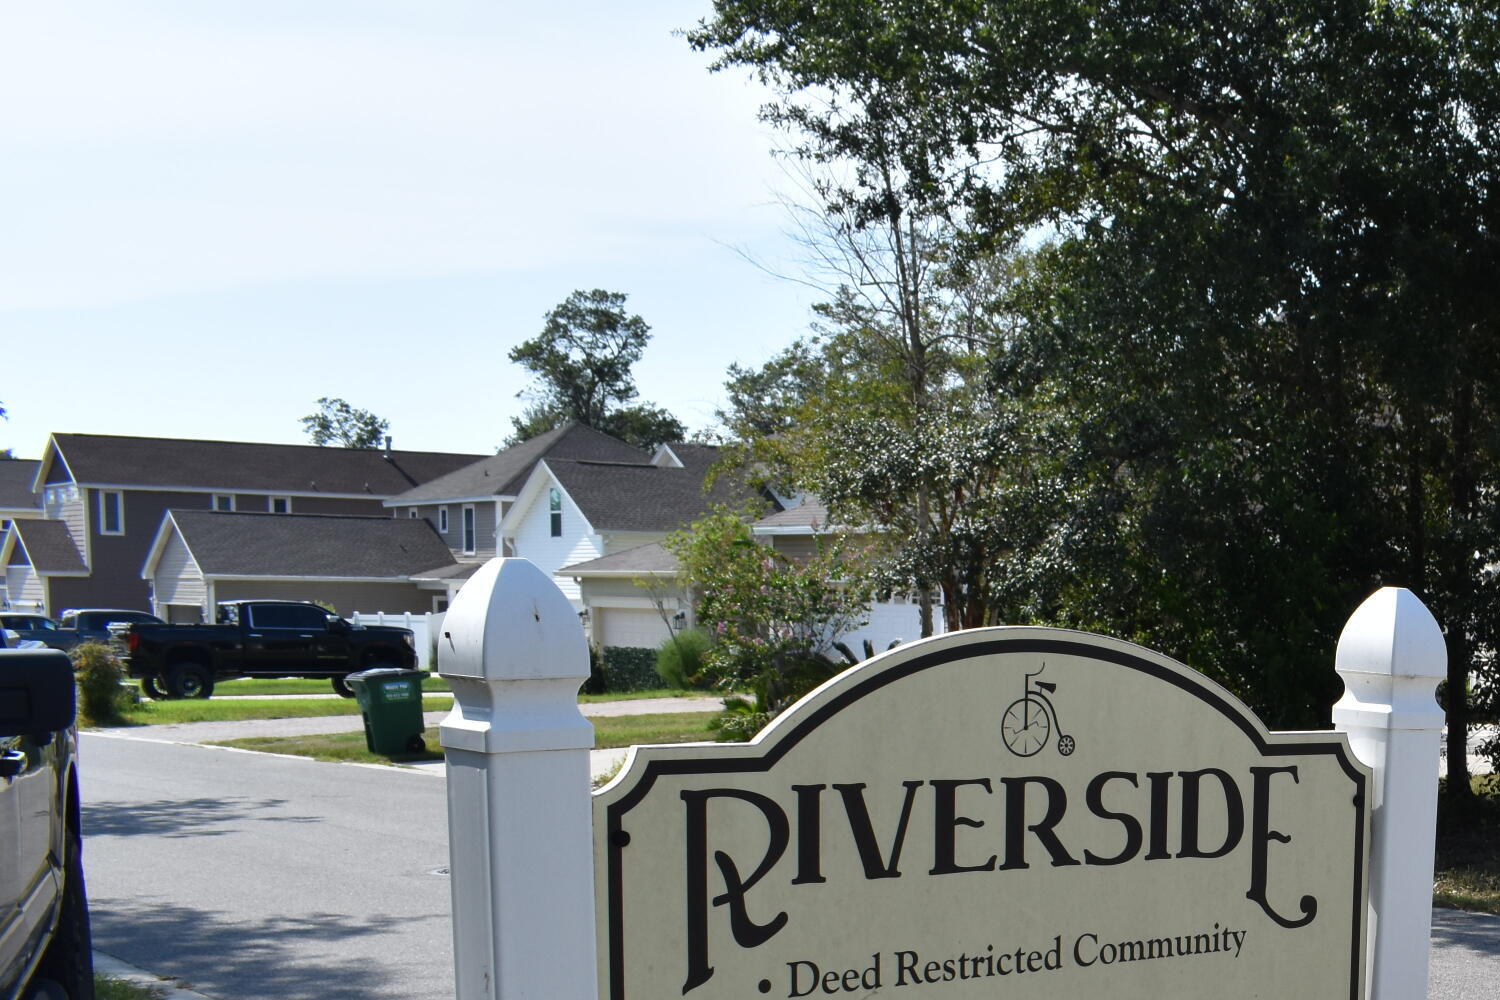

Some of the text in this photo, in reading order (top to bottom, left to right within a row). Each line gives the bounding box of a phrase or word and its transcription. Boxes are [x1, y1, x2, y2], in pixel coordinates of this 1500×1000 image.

[680, 765, 1317, 996] RIVERSIDE
[786, 922, 1247, 998] Deed Restricted Community
